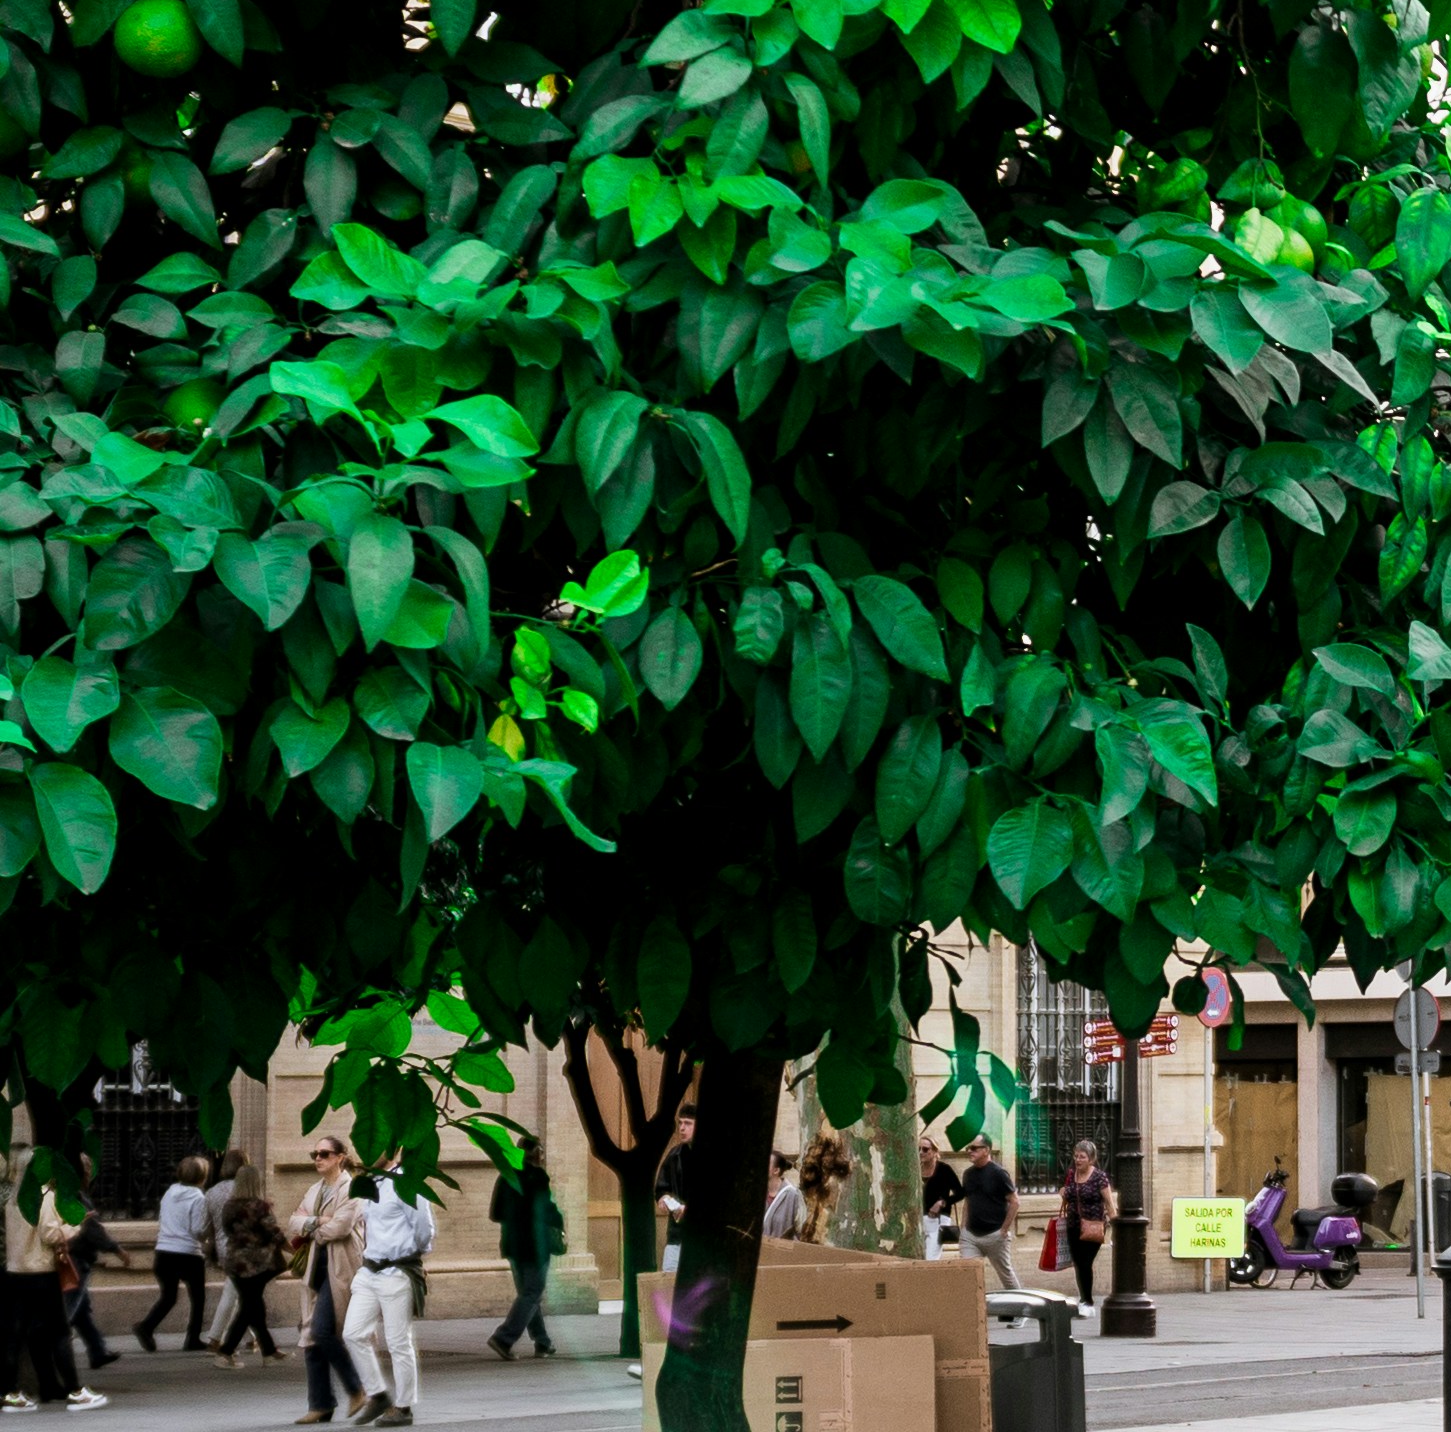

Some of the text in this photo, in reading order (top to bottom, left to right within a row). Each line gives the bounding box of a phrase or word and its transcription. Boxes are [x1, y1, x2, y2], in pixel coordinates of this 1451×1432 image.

[1185, 1207, 1233, 1217] SALIDA POR
[1195, 1223, 1222, 1232] CALLE
[1190, 1237, 1226, 1247] HARINAS
